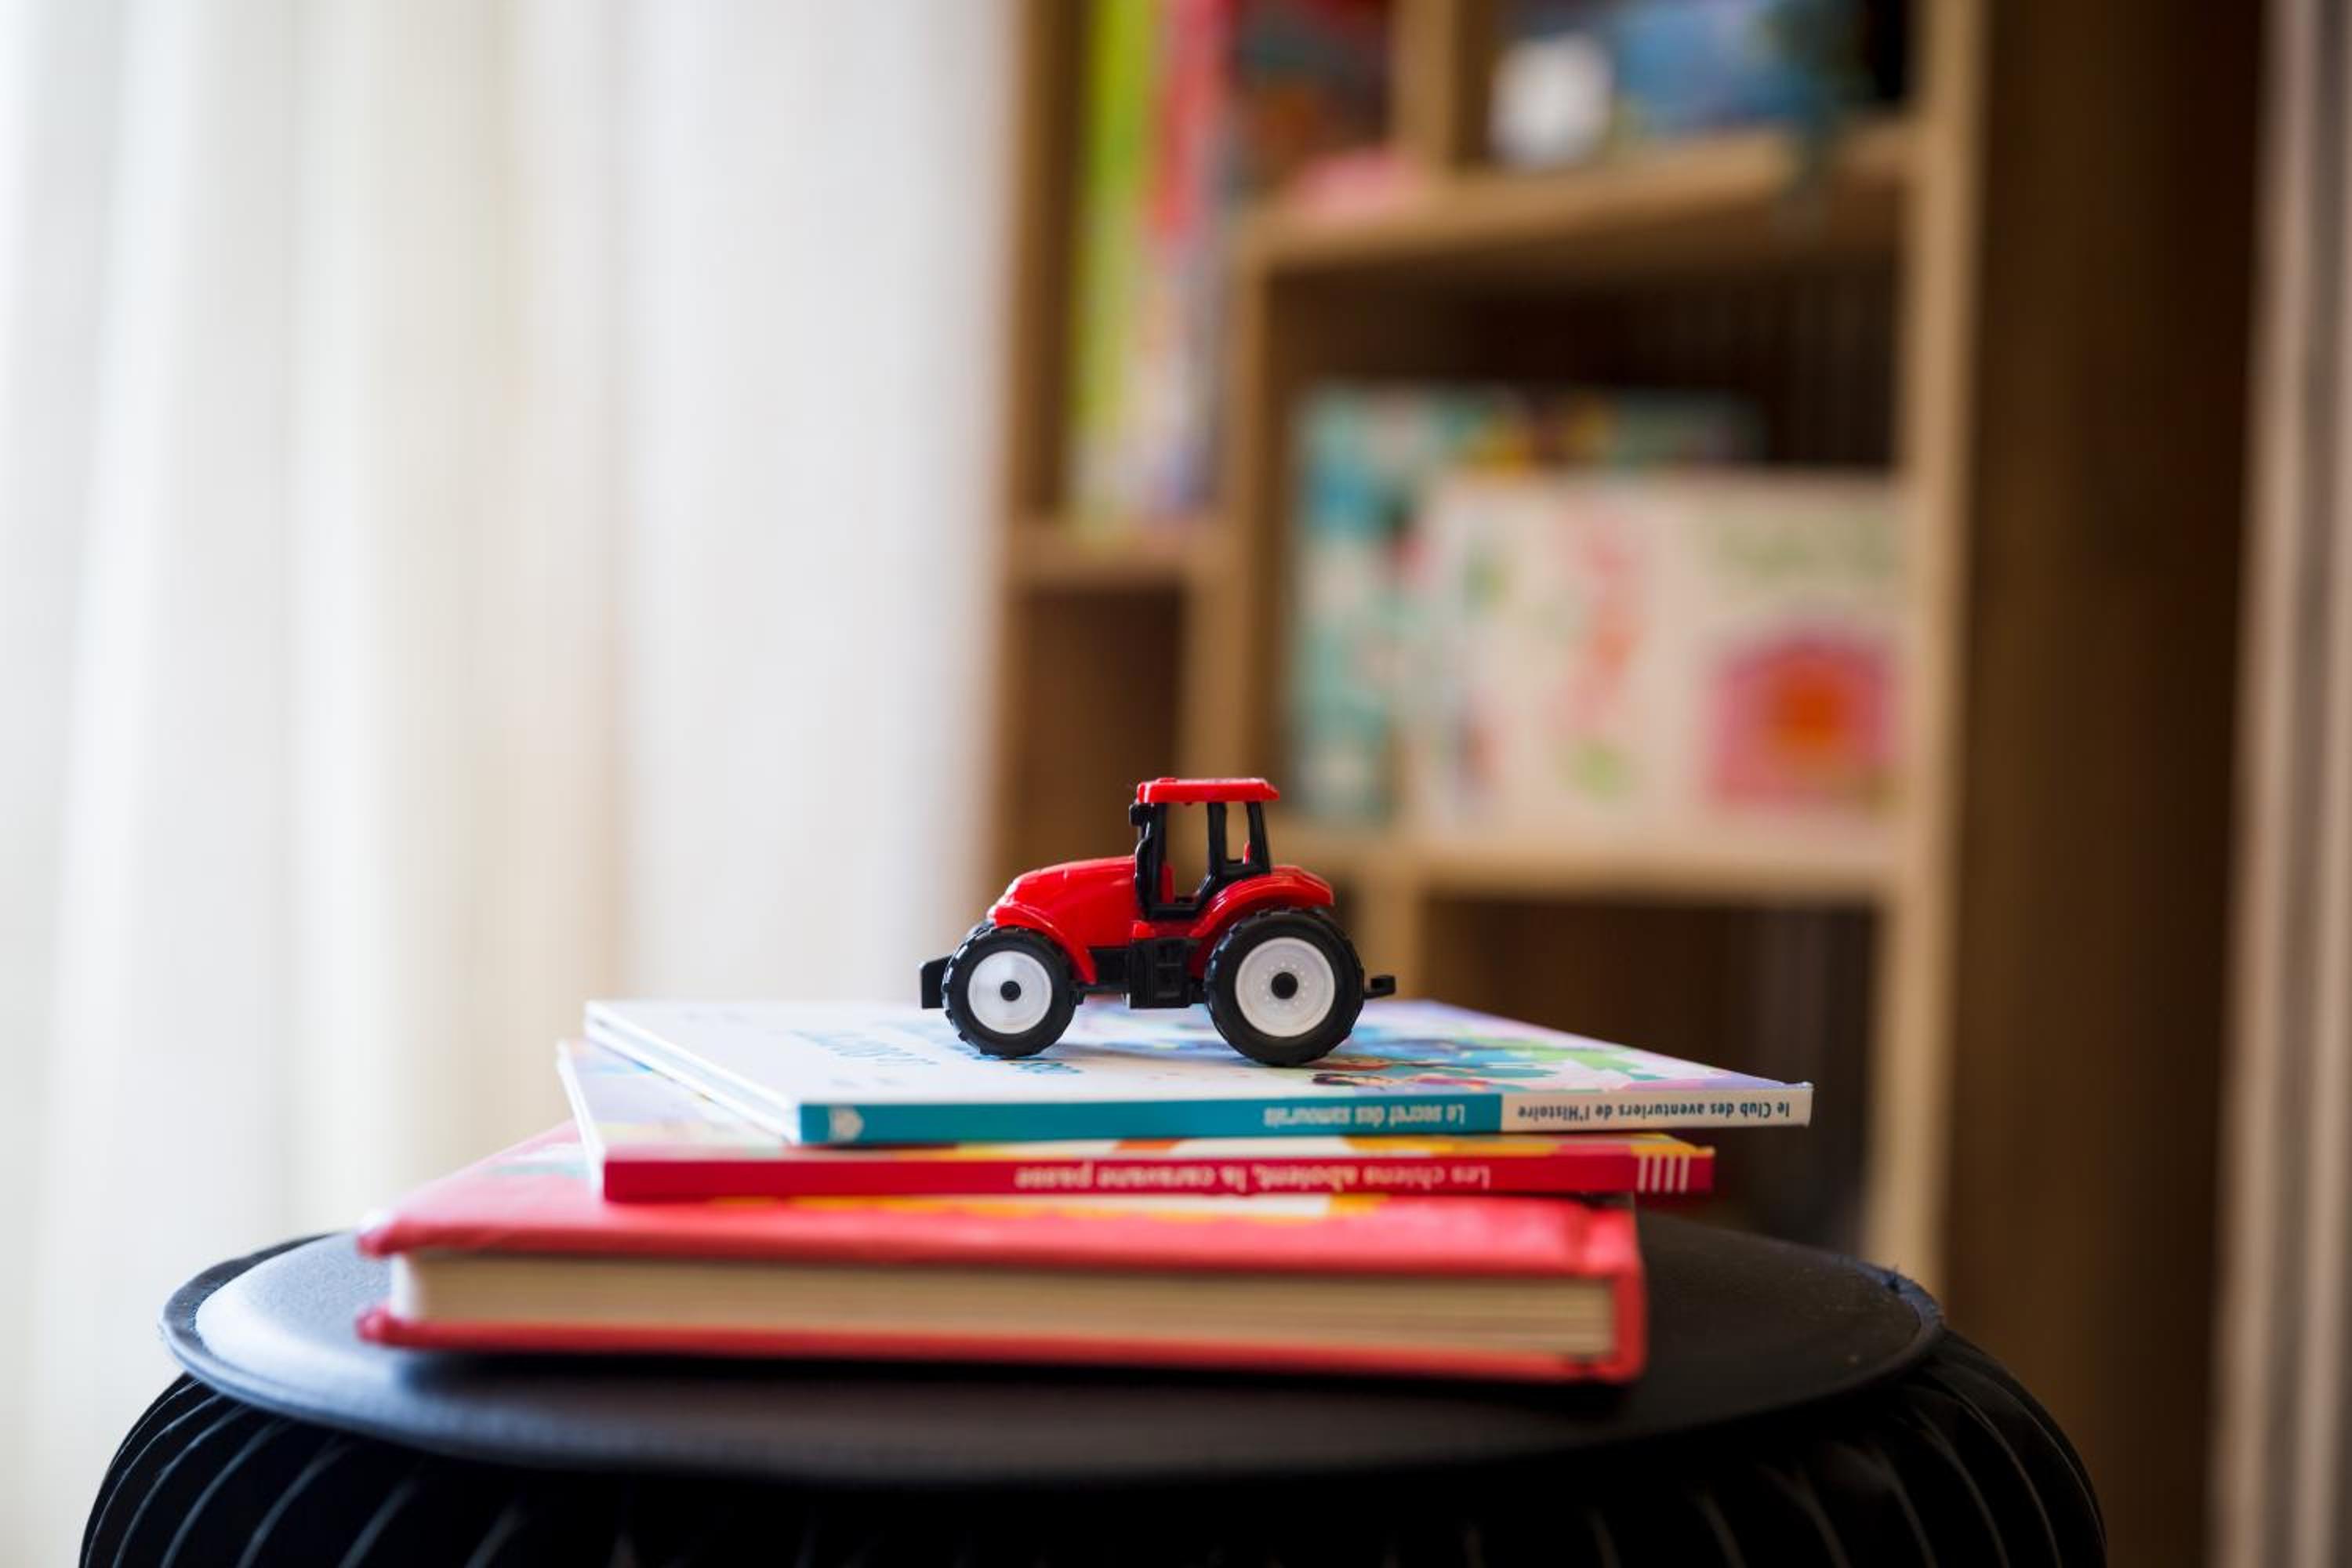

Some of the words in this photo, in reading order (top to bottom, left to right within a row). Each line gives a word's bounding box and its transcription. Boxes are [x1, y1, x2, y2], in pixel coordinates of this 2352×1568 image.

[1355, 1105, 1385, 1127] des
[1389, 1104, 1443, 1127] secret
[1447, 1104, 1465, 1124] Le
[1518, 1105, 1590, 1122] l'Histoire
[1595, 1105, 1612, 1122] de
[1618, 1104, 1704, 1120] aventuriers
[1711, 1102, 1734, 1120] des
[1740, 1101, 1771, 1119] Club
[1777, 1101, 1790, 1117] le
[1014, 1162, 1094, 1188] passe
[1098, 1166, 1215, 1189] caravane
[1221, 1166, 1247, 1192] la
[1254, 1164, 1359, 1192] aboient,
[1364, 1166, 1446, 1190] chiens
[1451, 1166, 1490, 1190] Les
